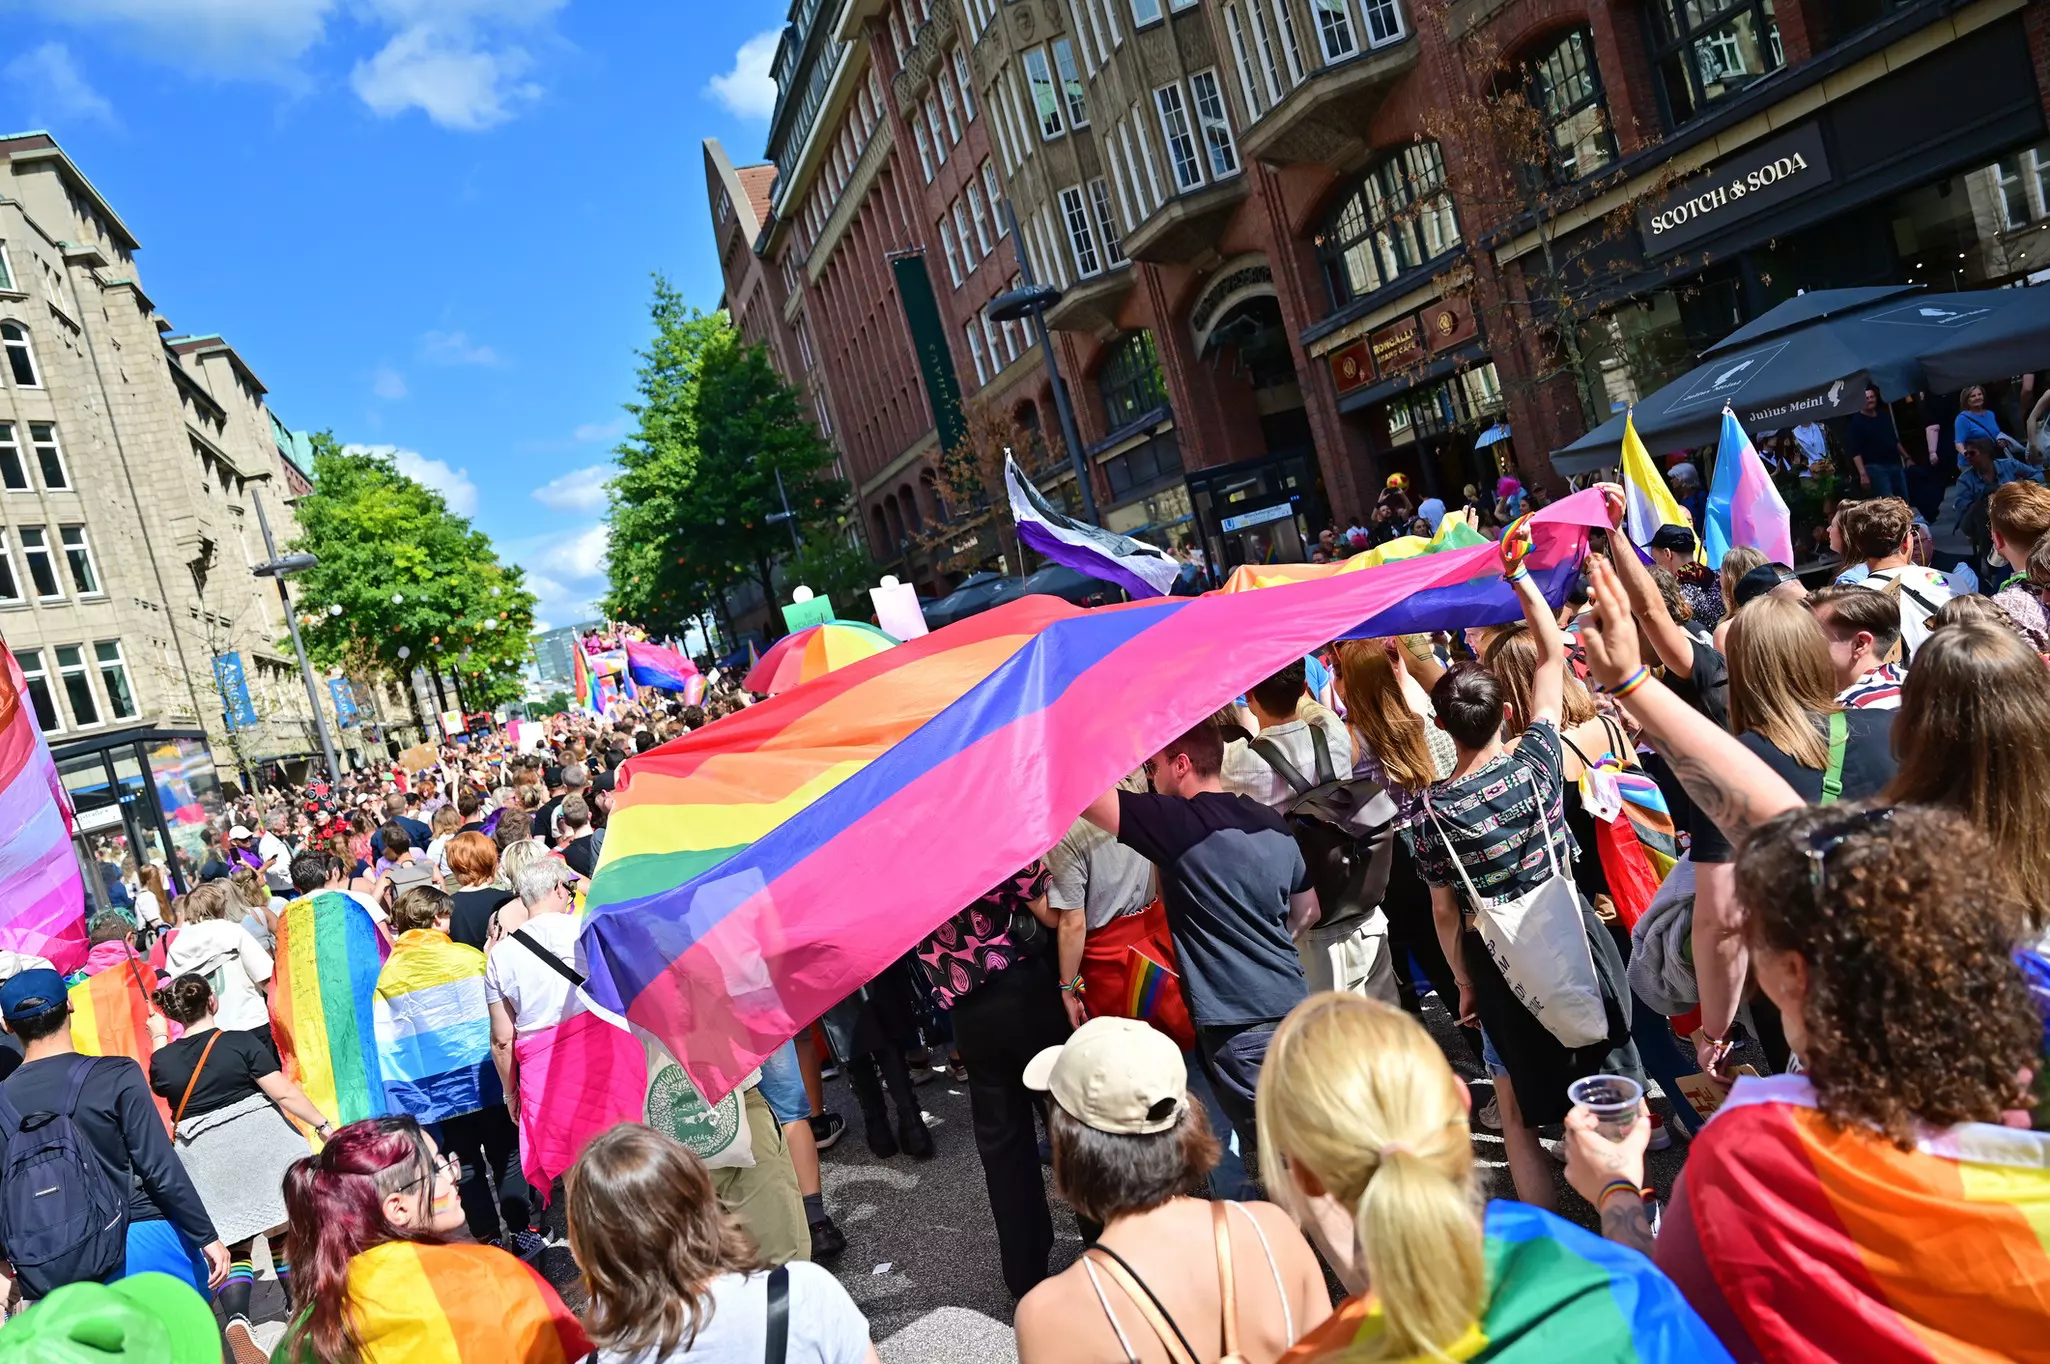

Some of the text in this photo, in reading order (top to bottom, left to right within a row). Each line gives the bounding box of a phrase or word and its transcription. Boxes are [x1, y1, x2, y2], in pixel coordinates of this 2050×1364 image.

[1650, 152, 1808, 235] SCOTCH & SODA
[1749, 395, 1824, 422] Julius Meinl
